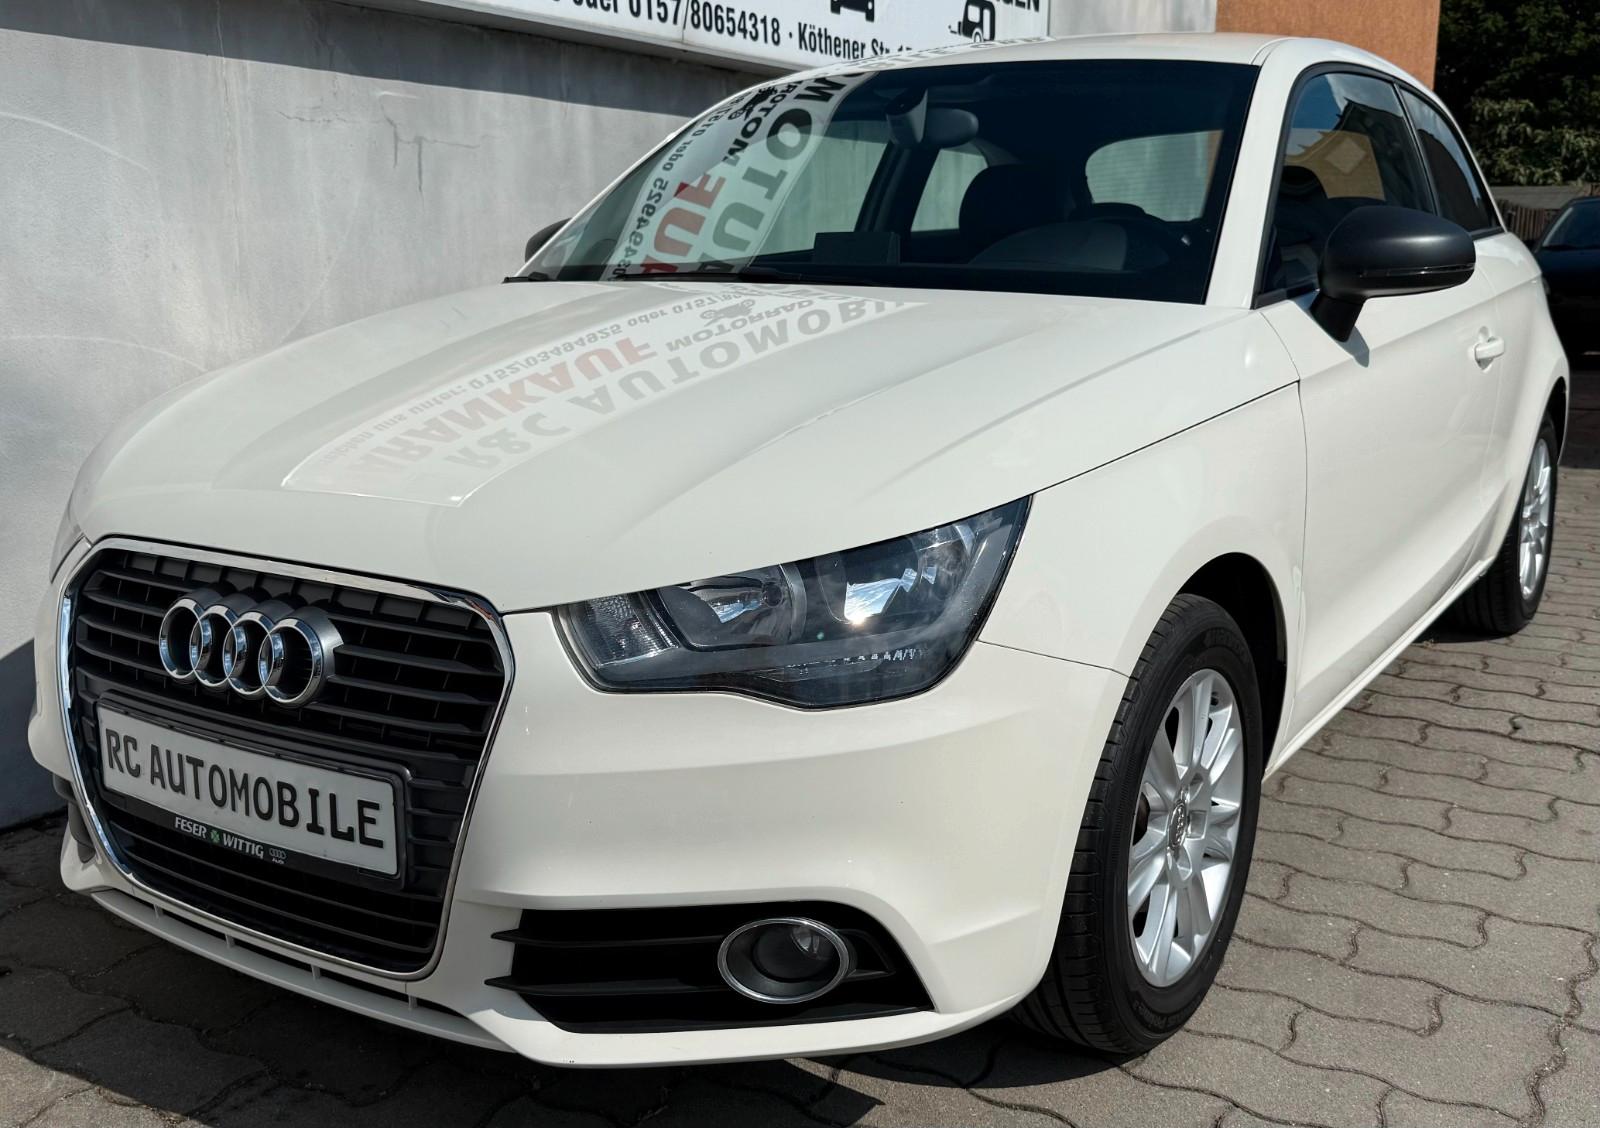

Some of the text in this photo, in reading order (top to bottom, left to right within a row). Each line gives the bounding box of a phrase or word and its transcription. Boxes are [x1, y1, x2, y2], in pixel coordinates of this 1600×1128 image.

[798, 22, 866, 60] Köthener
[105, 728, 384, 849] RC AUTOMOBILE
[175, 816, 264, 859] FESER WITTIG
